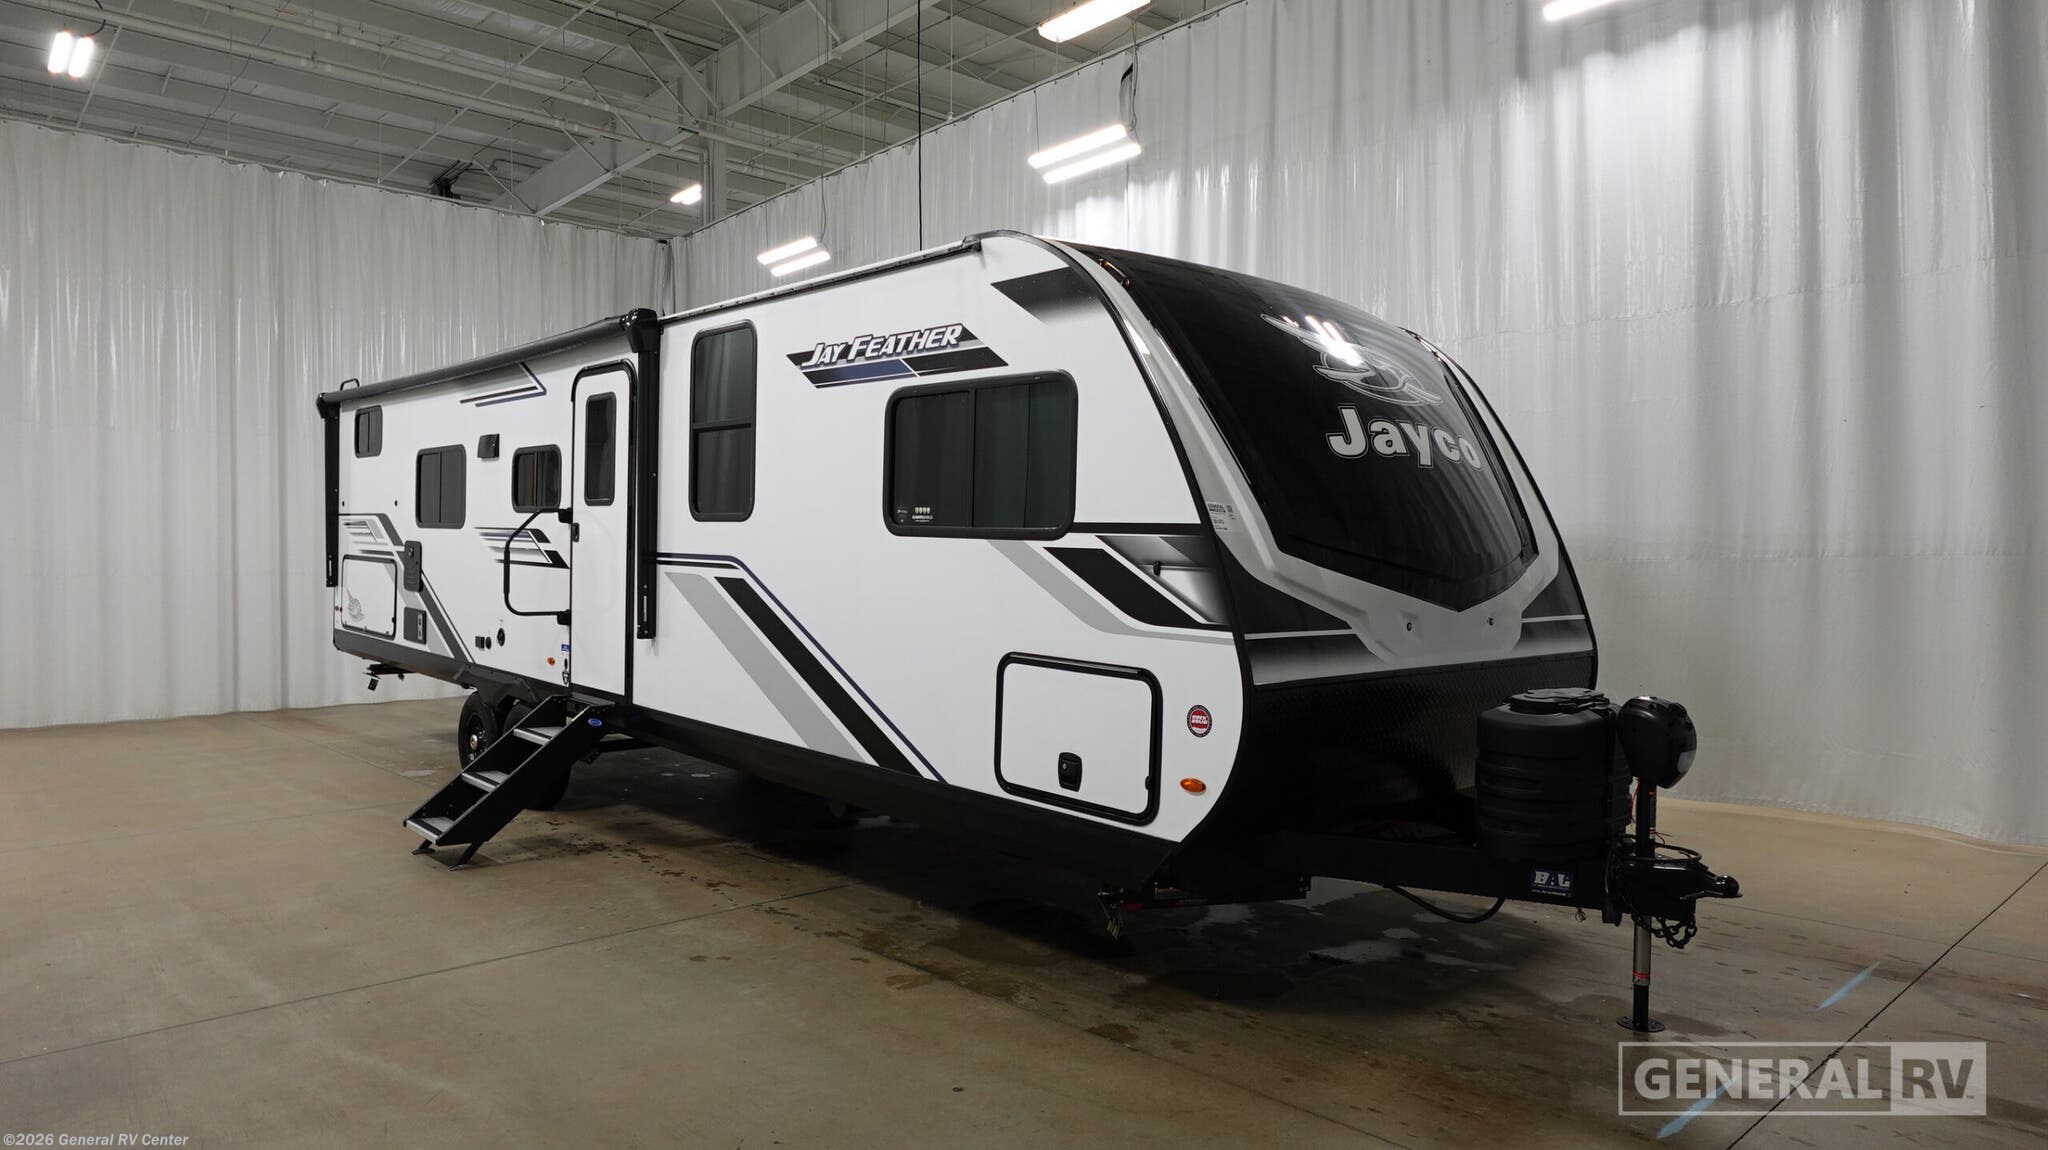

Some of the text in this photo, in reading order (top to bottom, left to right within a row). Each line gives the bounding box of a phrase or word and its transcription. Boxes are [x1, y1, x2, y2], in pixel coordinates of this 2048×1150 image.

[801, 323, 963, 367] JAY FEATHER
[1327, 406, 1481, 470] Jayco
